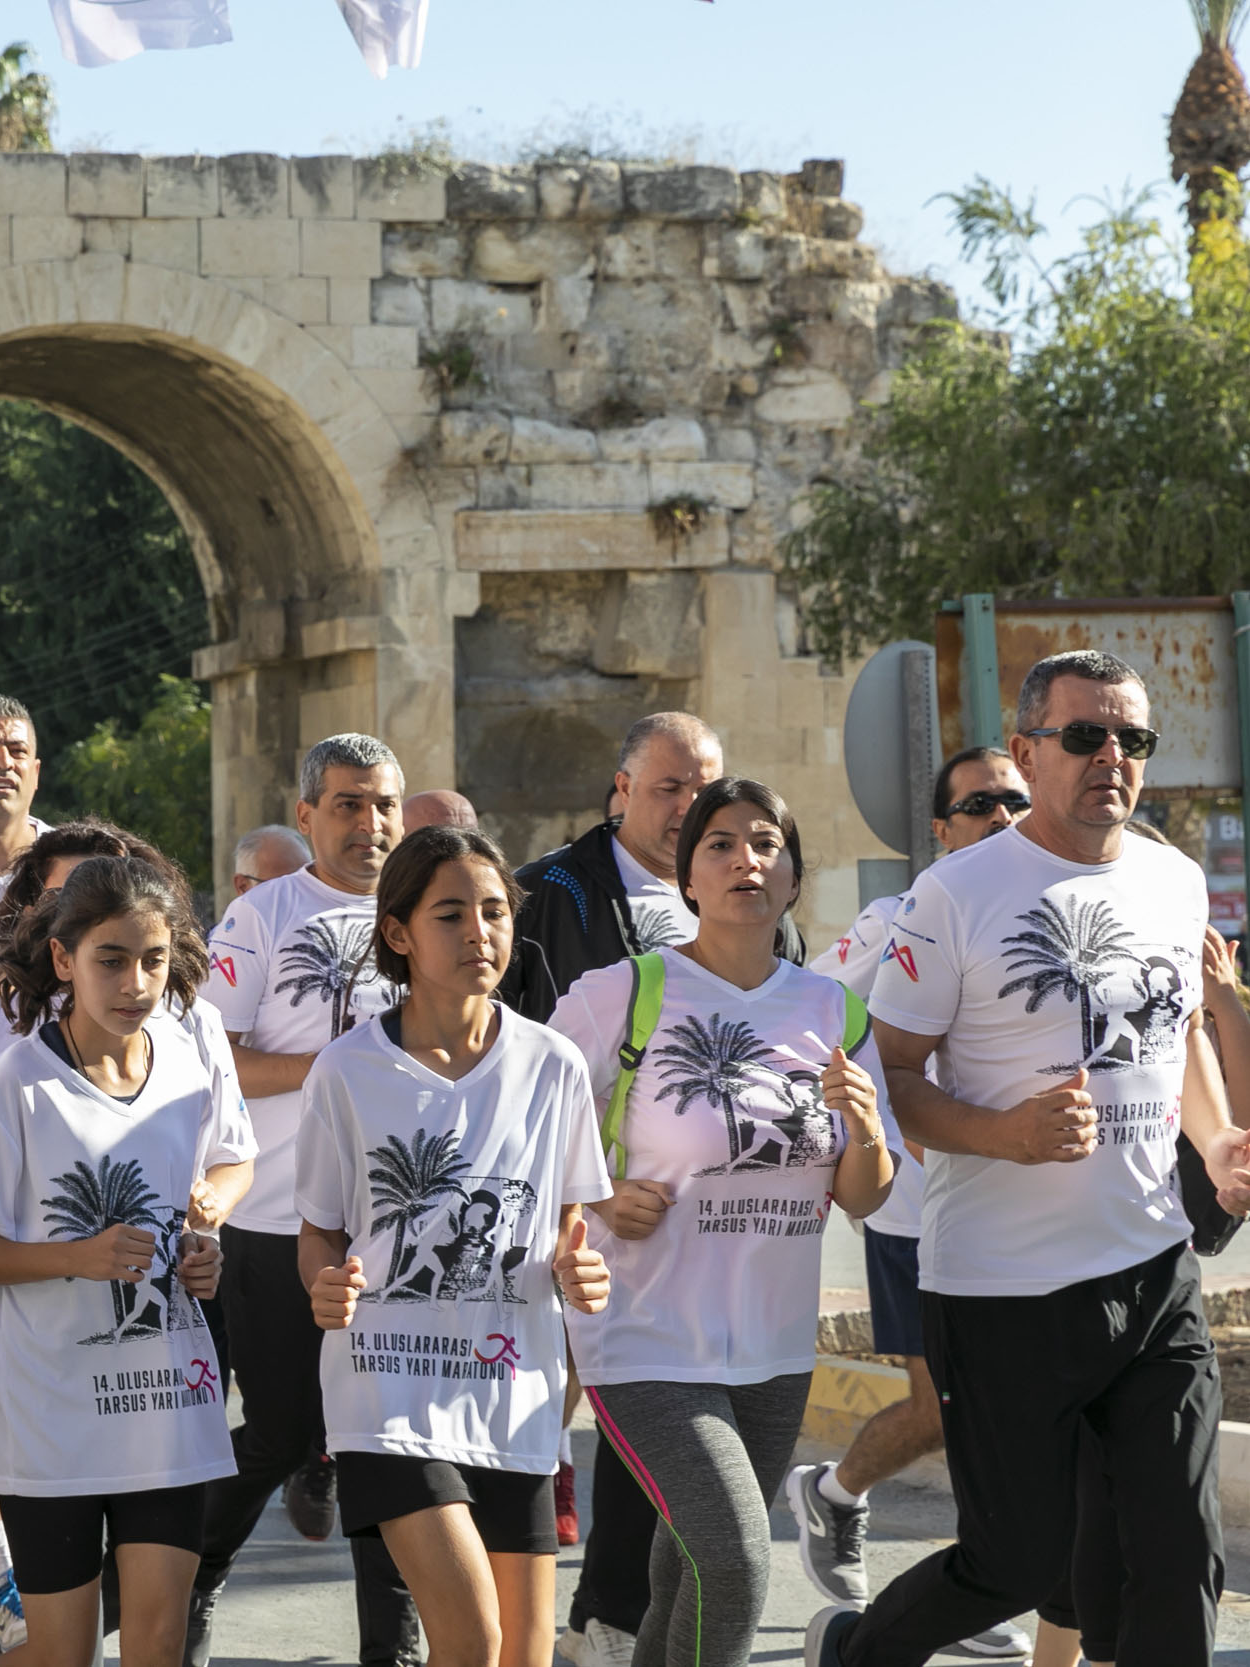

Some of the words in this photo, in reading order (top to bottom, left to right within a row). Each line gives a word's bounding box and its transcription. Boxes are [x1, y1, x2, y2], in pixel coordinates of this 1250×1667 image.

[1113, 1125, 1139, 1145] YARI
[699, 1200, 717, 1217] 14.
[722, 1199, 814, 1218] ULUSLARARASI
[698, 1217, 746, 1235] TARSUS
[753, 1217, 782, 1237] YARI
[351, 1333, 370, 1351] 14.
[374, 1333, 472, 1358] ULUSLARARASI
[351, 1355, 400, 1374] TARSUS
[406, 1357, 436, 1376] YARI
[93, 1375, 114, 1393] 14.
[95, 1393, 146, 1415] TARSUS
[151, 1391, 179, 1411] YARI
